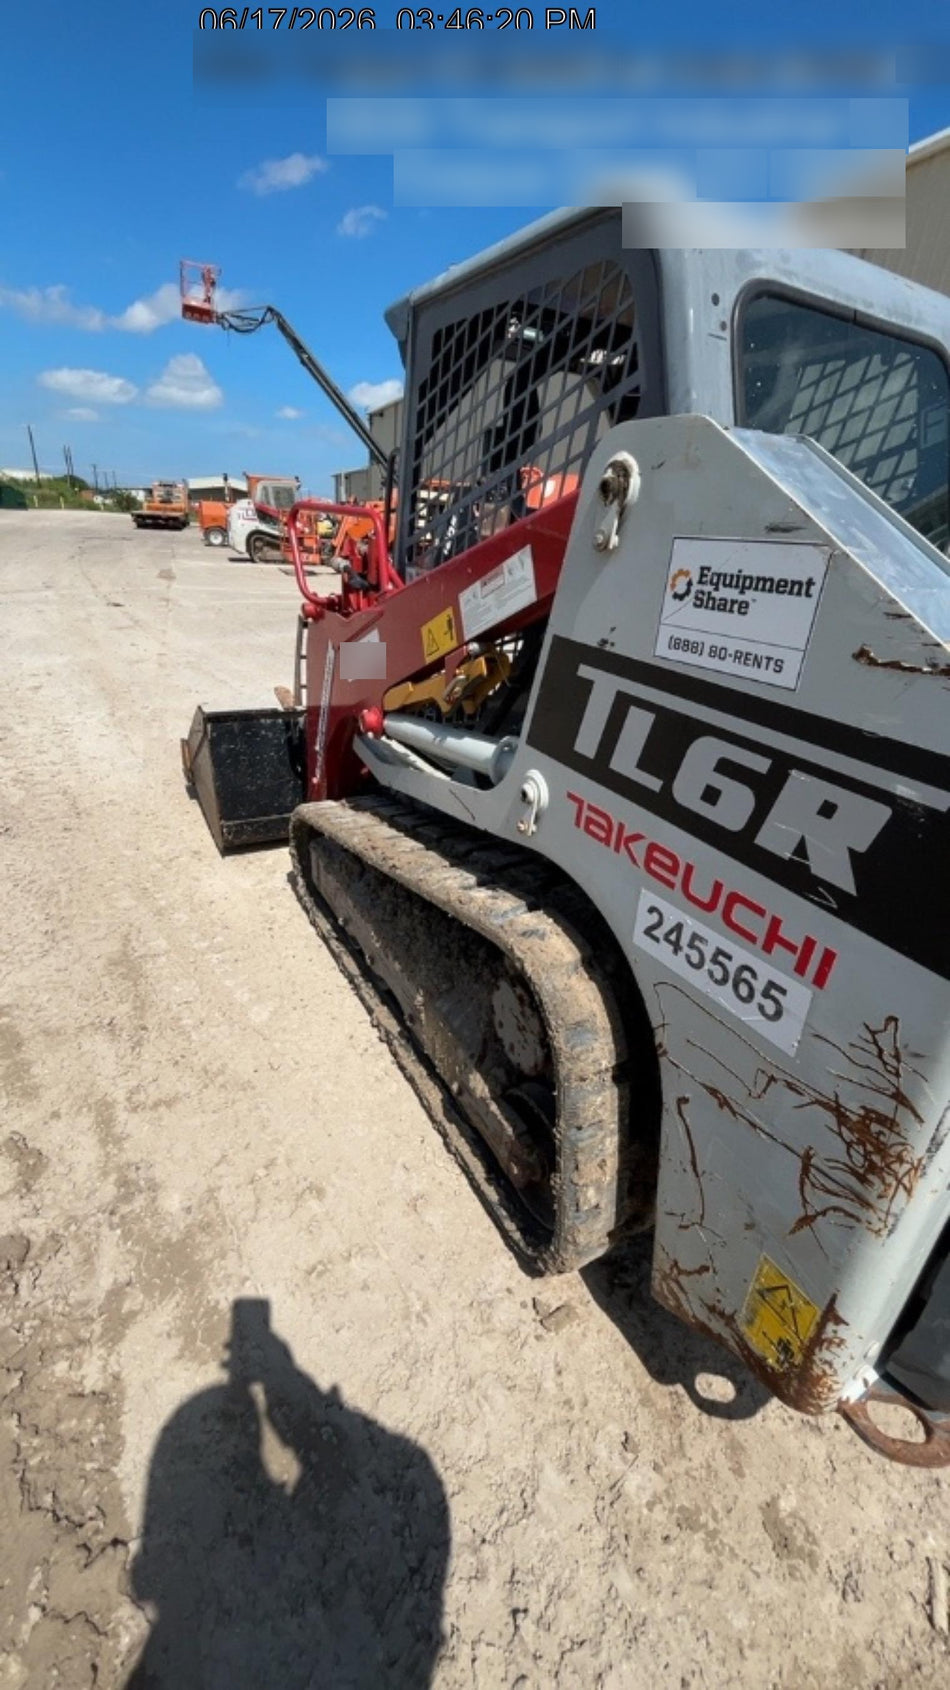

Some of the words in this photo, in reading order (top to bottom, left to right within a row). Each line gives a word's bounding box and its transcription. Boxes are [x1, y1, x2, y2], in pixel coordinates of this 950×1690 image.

[692, 589, 750, 616] Share
[696, 566, 816, 599] Equipment
[668, 634, 704, 656] (888)
[708, 644, 785, 674] 80-RENTS
[573, 663, 895, 897] TL6R
[643, 905, 788, 1024] 245565
